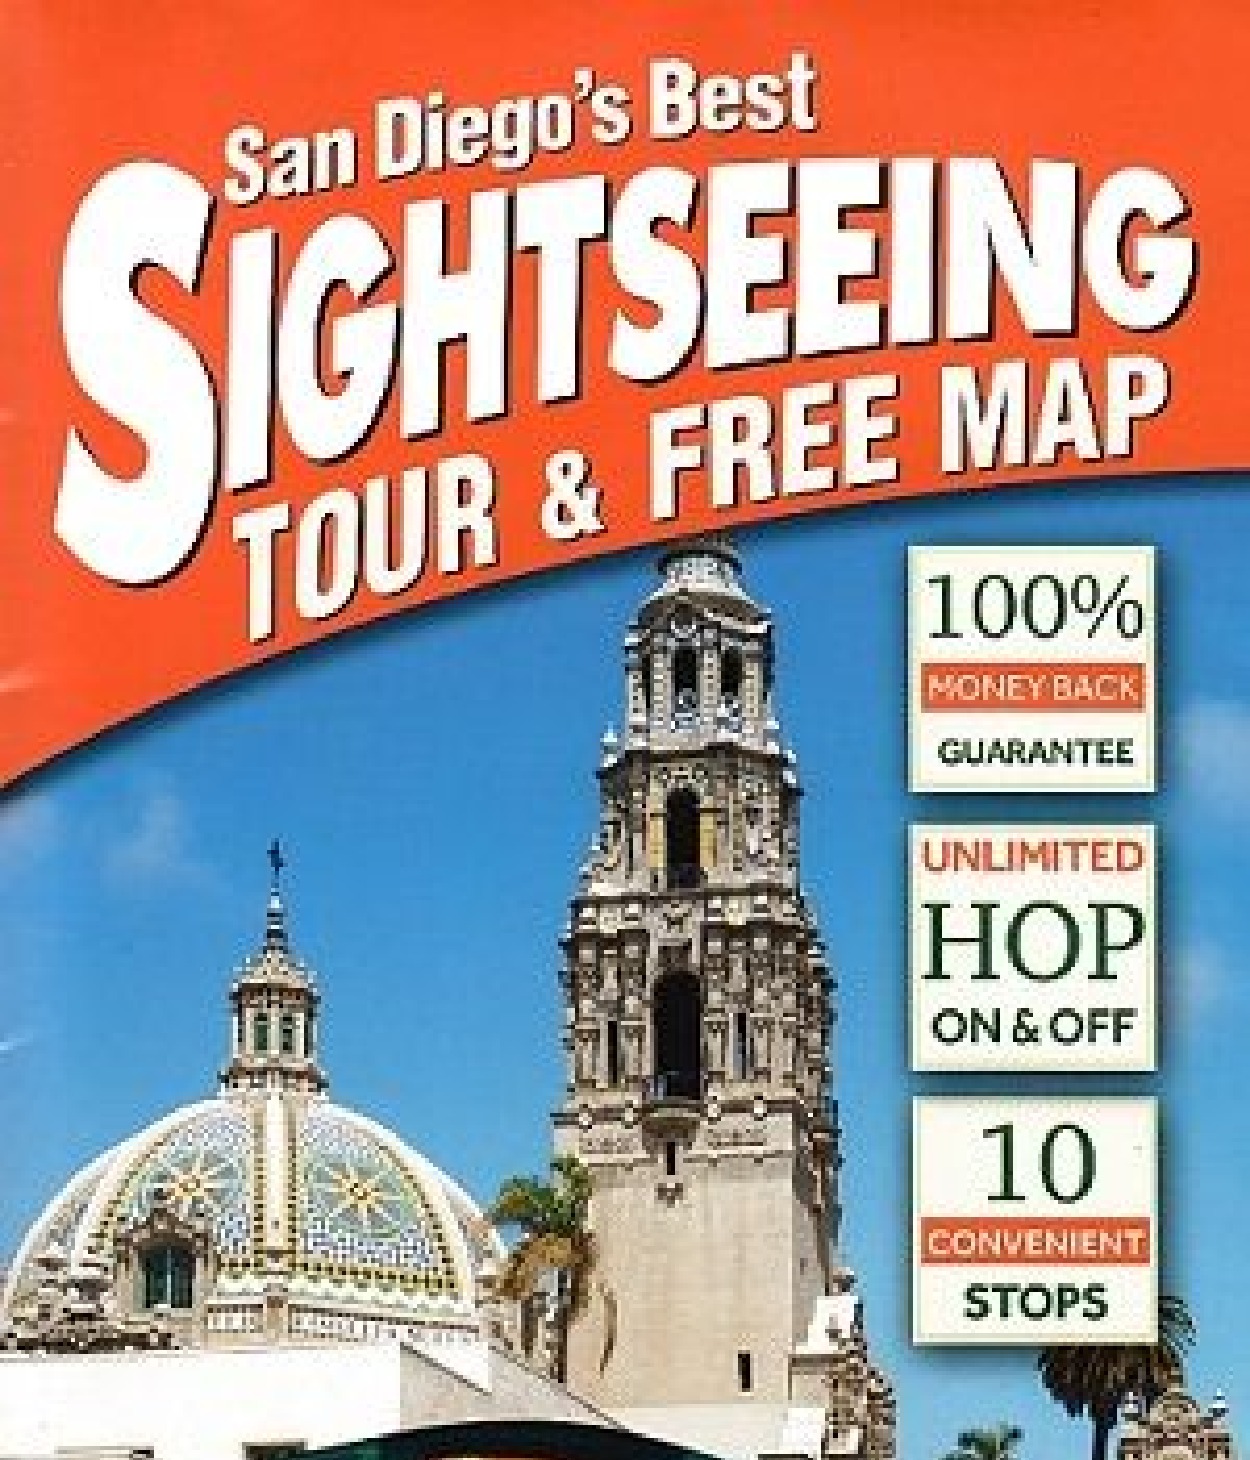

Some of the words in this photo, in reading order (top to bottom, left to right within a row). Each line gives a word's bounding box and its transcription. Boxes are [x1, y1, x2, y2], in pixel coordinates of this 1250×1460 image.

[223, 124, 357, 205] San
[376, 66, 632, 182] Diego's
[649, 52, 818, 139] Best
[52, 158, 1196, 588] SIGHTSEEING
[232, 450, 498, 645] TOUR
[540, 448, 606, 542] &
[648, 375, 900, 523] FREE
[939, 354, 1171, 477] MAP
[927, 573, 1144, 640] 100%
[927, 673, 1044, 703] MONEY
[1054, 673, 1140, 703] BACK
[937, 737, 1134, 768] GUARANTEE
[921, 841, 1144, 873] UNLIMITED
[920, 899, 1146, 984] HOP
[932, 1008, 1001, 1046] ON
[1012, 1008, 1041, 1046] &
[1049, 1008, 1138, 1046] OFF
[982, 1124, 1097, 1205] 10
[926, 1229, 1145, 1258] CONVENIENT
[962, 1283, 1109, 1321] STOPS
